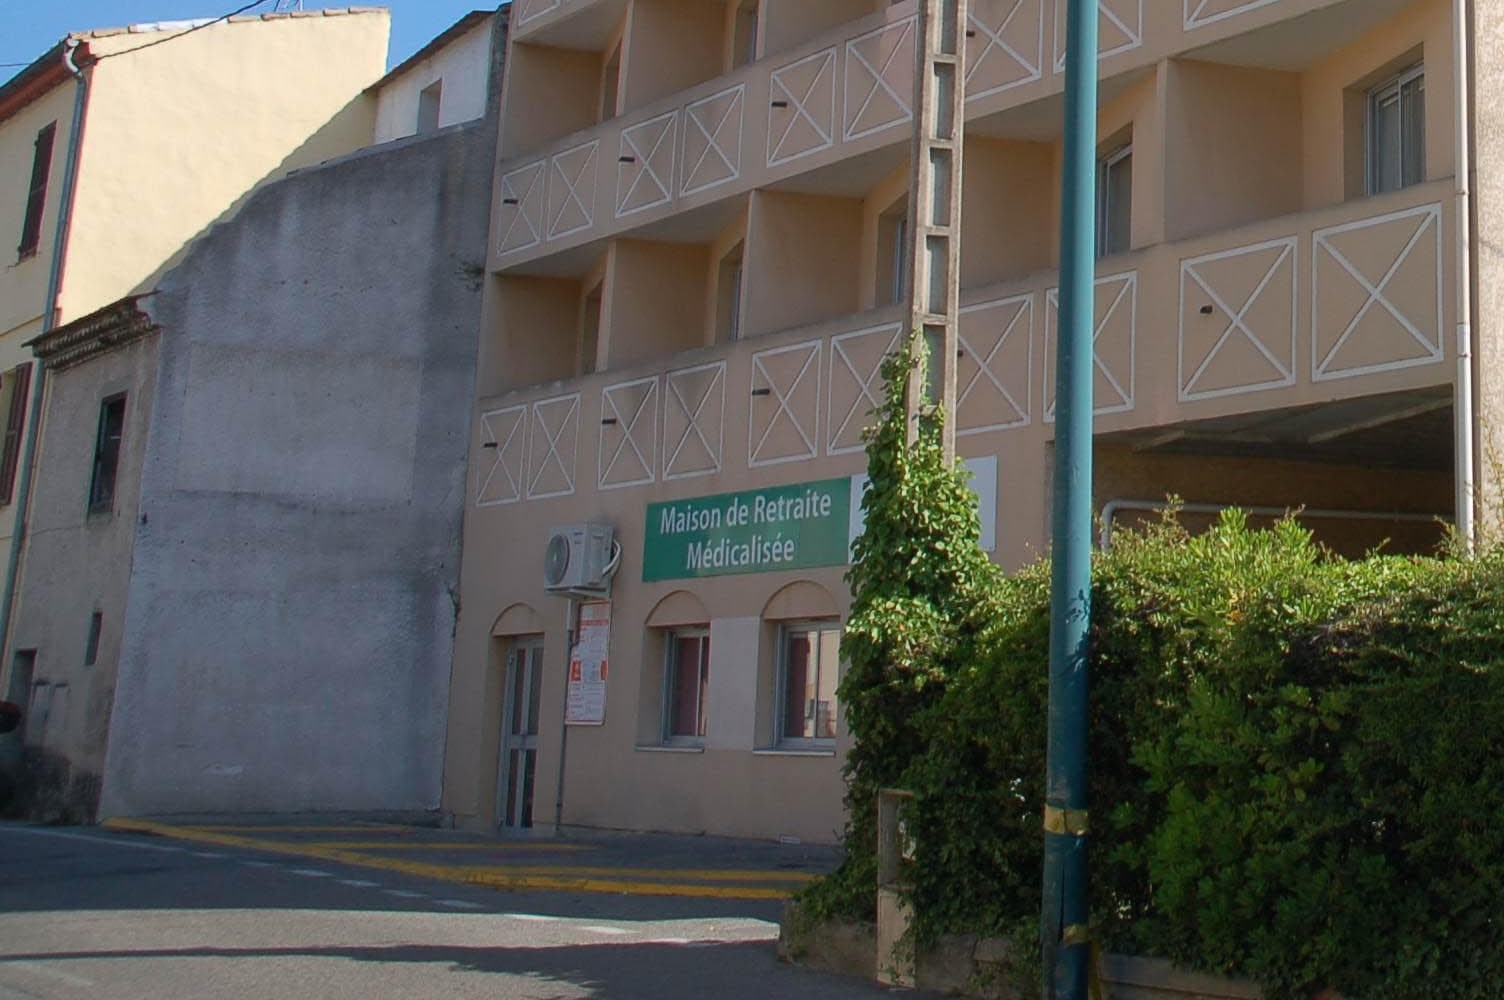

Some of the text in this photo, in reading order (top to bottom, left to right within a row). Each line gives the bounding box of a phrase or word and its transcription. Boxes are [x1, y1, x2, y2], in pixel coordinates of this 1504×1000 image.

[660, 488, 832, 535] Maison de Retraite
[687, 533, 795, 570] Médicalisée
